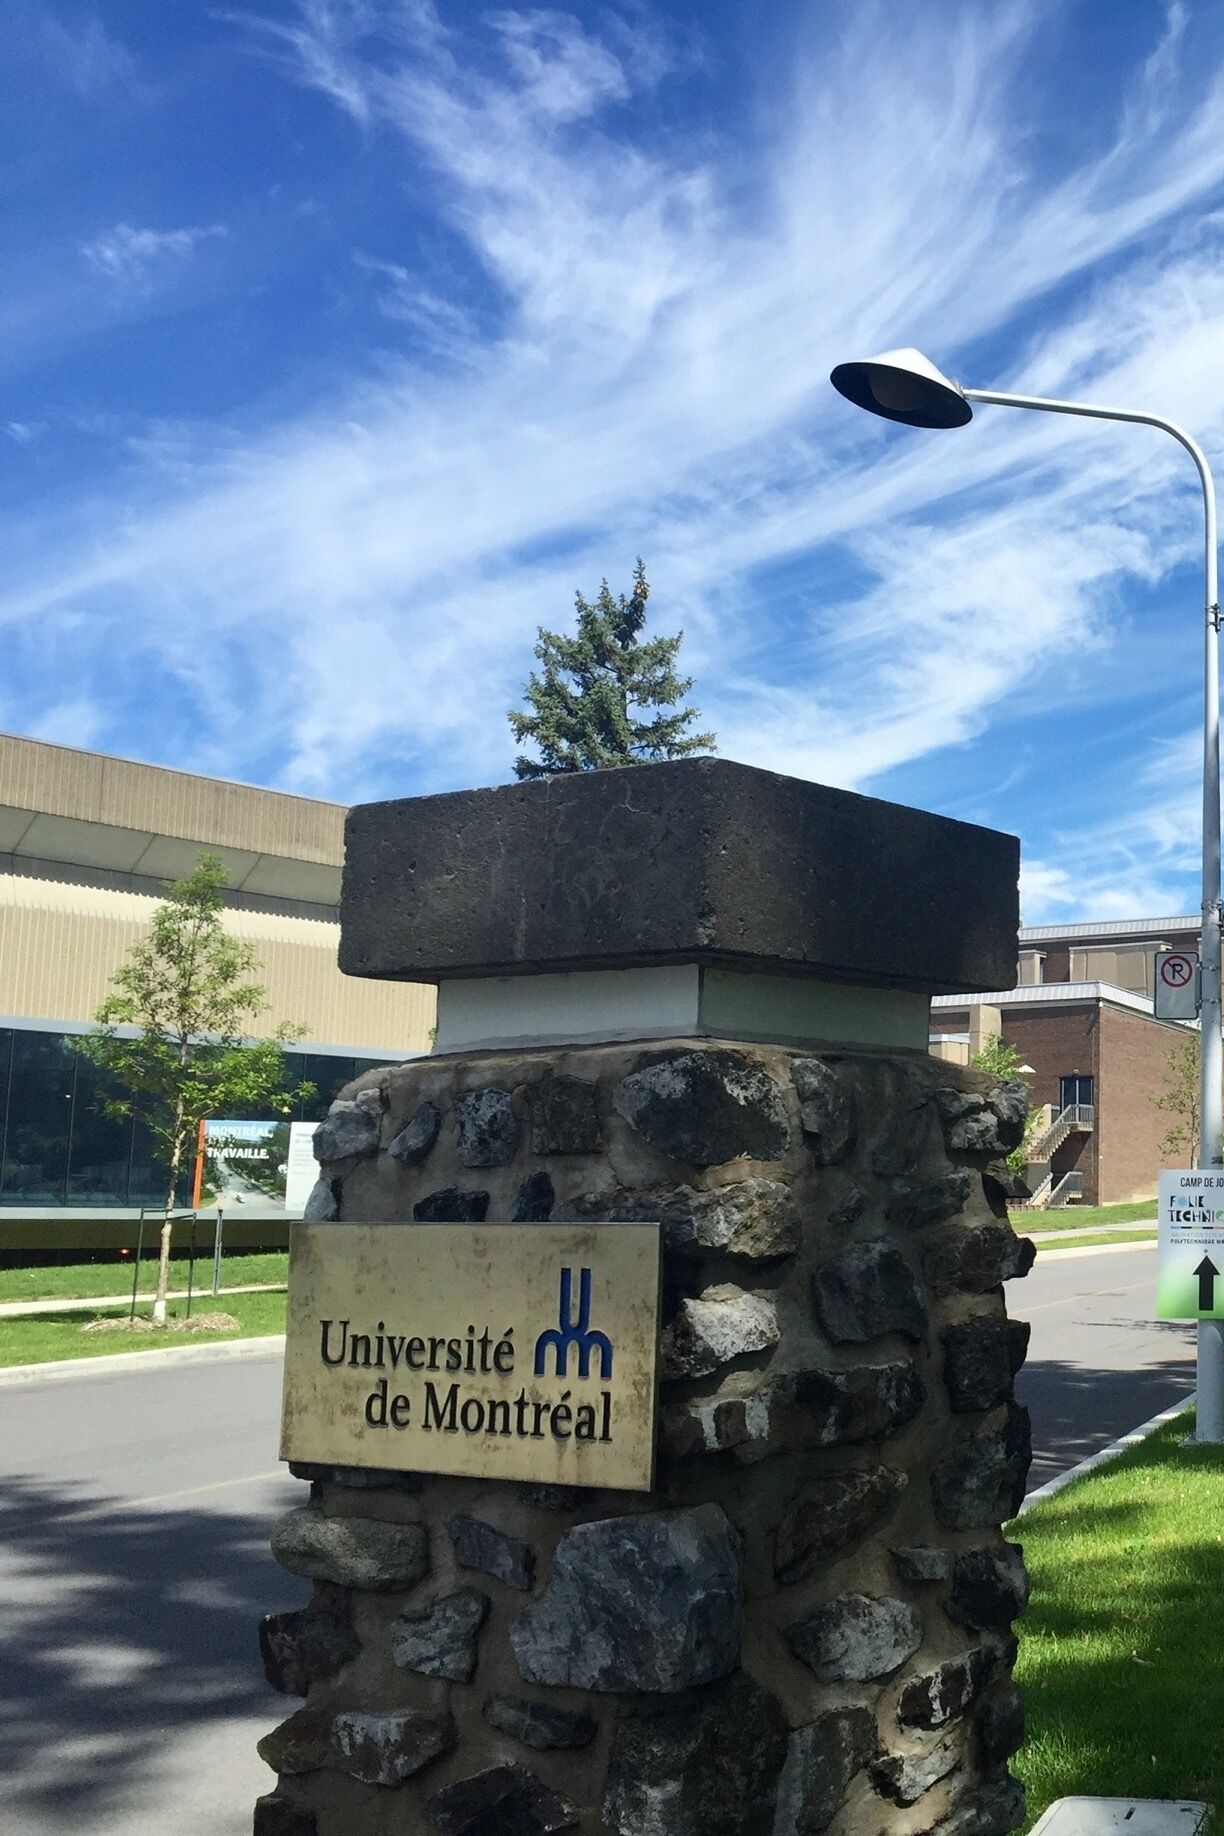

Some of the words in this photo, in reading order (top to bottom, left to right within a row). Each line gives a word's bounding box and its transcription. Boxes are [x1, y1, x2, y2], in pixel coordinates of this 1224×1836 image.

[1180, 1177, 1203, 1187] CAMP
[1204, 1177, 1214, 1187] DE
[319, 1320, 515, 1374] Université
[365, 1377, 411, 1428] de
[421, 1381, 613, 1442] Montréal
